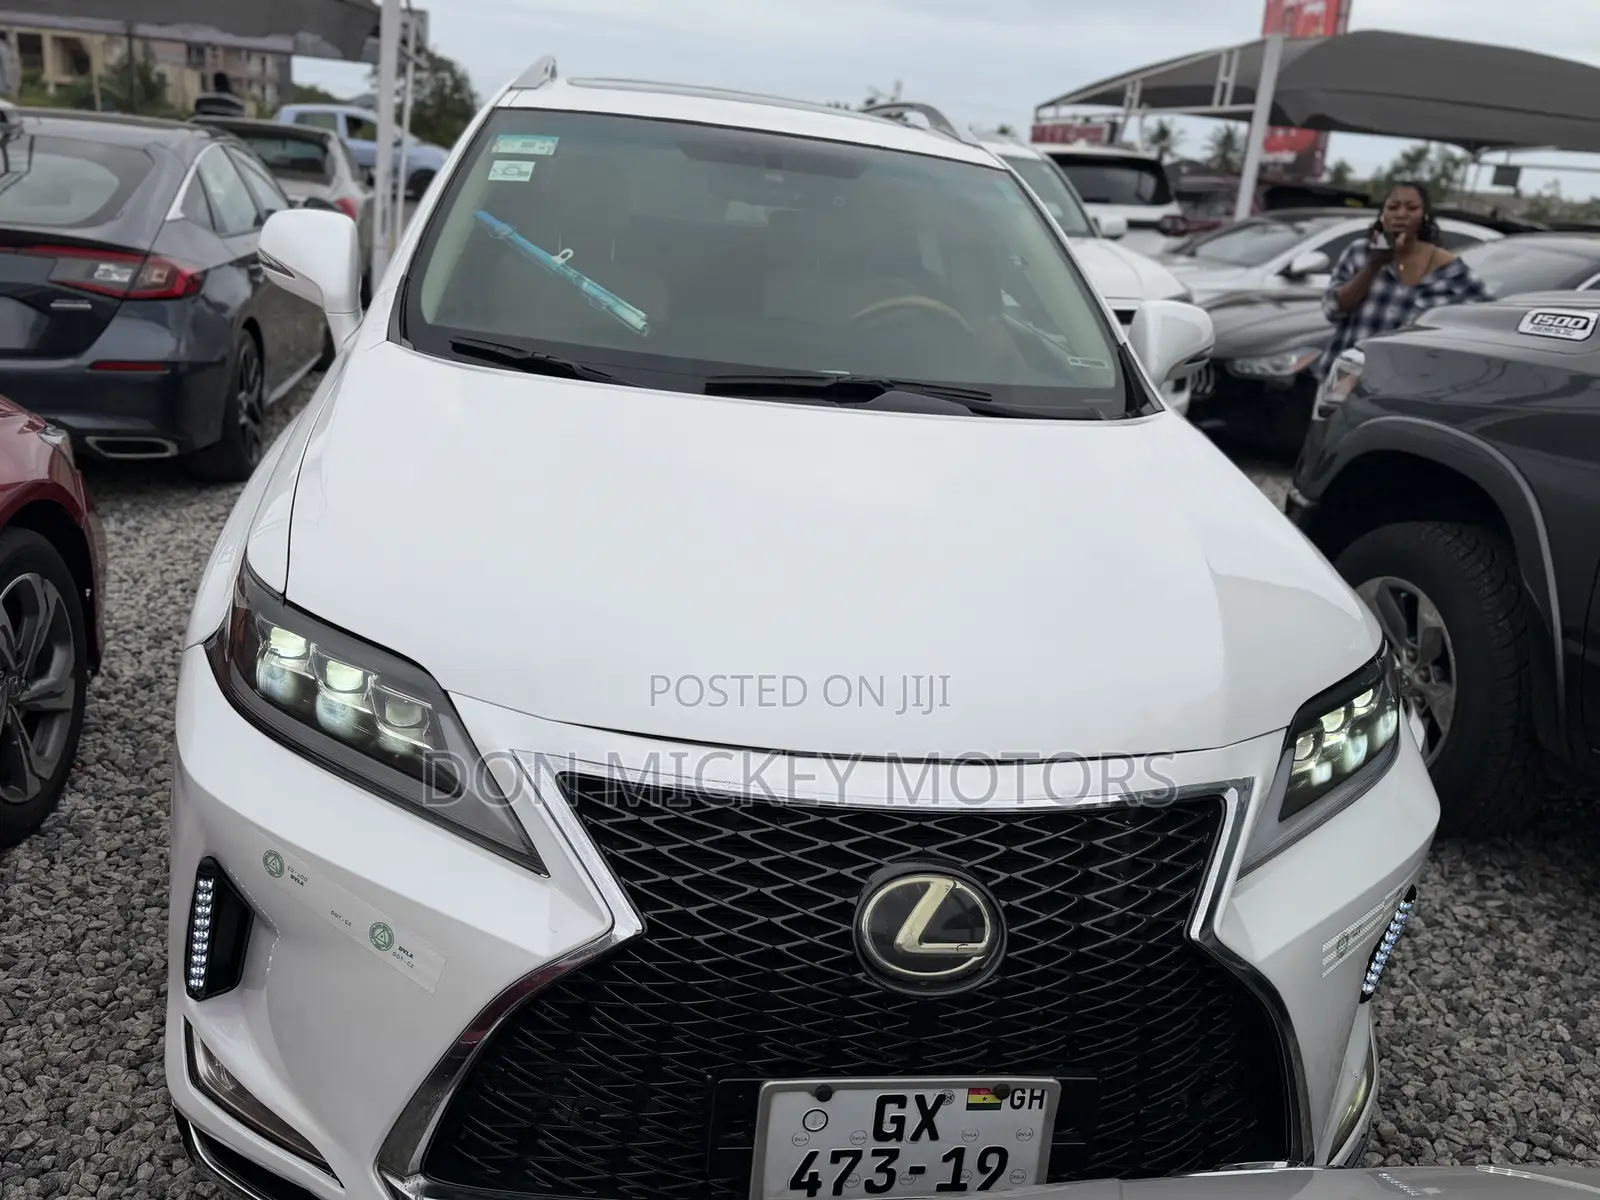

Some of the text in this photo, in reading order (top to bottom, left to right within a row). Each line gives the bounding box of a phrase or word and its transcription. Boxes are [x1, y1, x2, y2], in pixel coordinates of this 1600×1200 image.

[1532, 314, 1589, 329] 1500
[398, 945, 414, 959] DVLA
[1009, 1088, 1046, 1110] GH
[873, 1093, 946, 1142] GX
[789, 1146, 1009, 1197] 473-19
